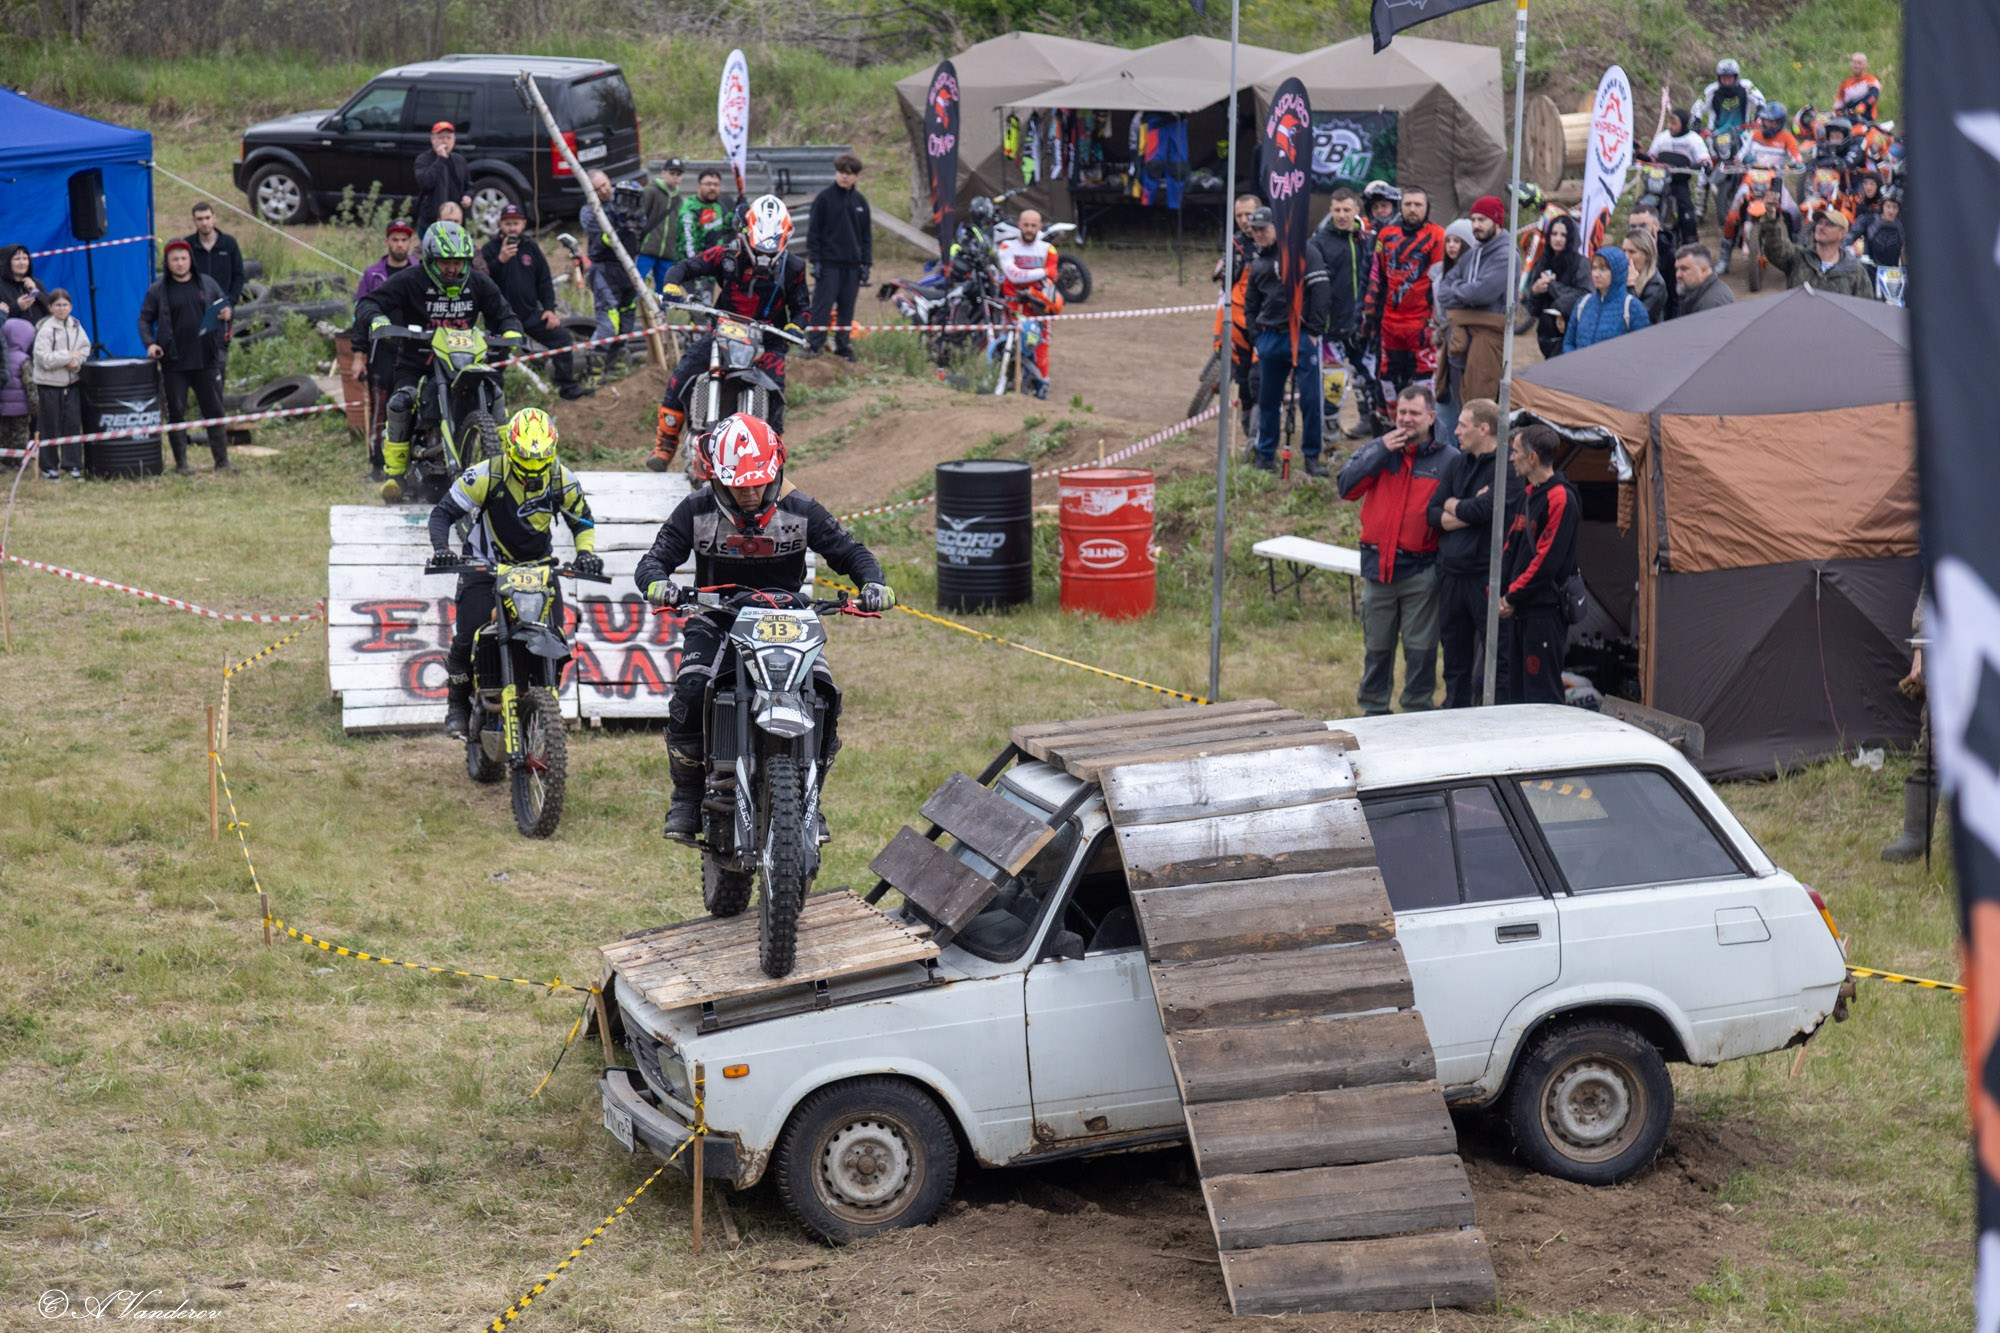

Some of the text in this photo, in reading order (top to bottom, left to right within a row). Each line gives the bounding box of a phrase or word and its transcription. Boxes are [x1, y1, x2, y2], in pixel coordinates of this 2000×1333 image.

[1266, 93, 1310, 138] ENDURO
[99, 410, 162, 427] RECOR
[735, 470, 765, 486] GTX
[936, 529, 1006, 548] ECORD
[769, 623, 788, 636] 13
